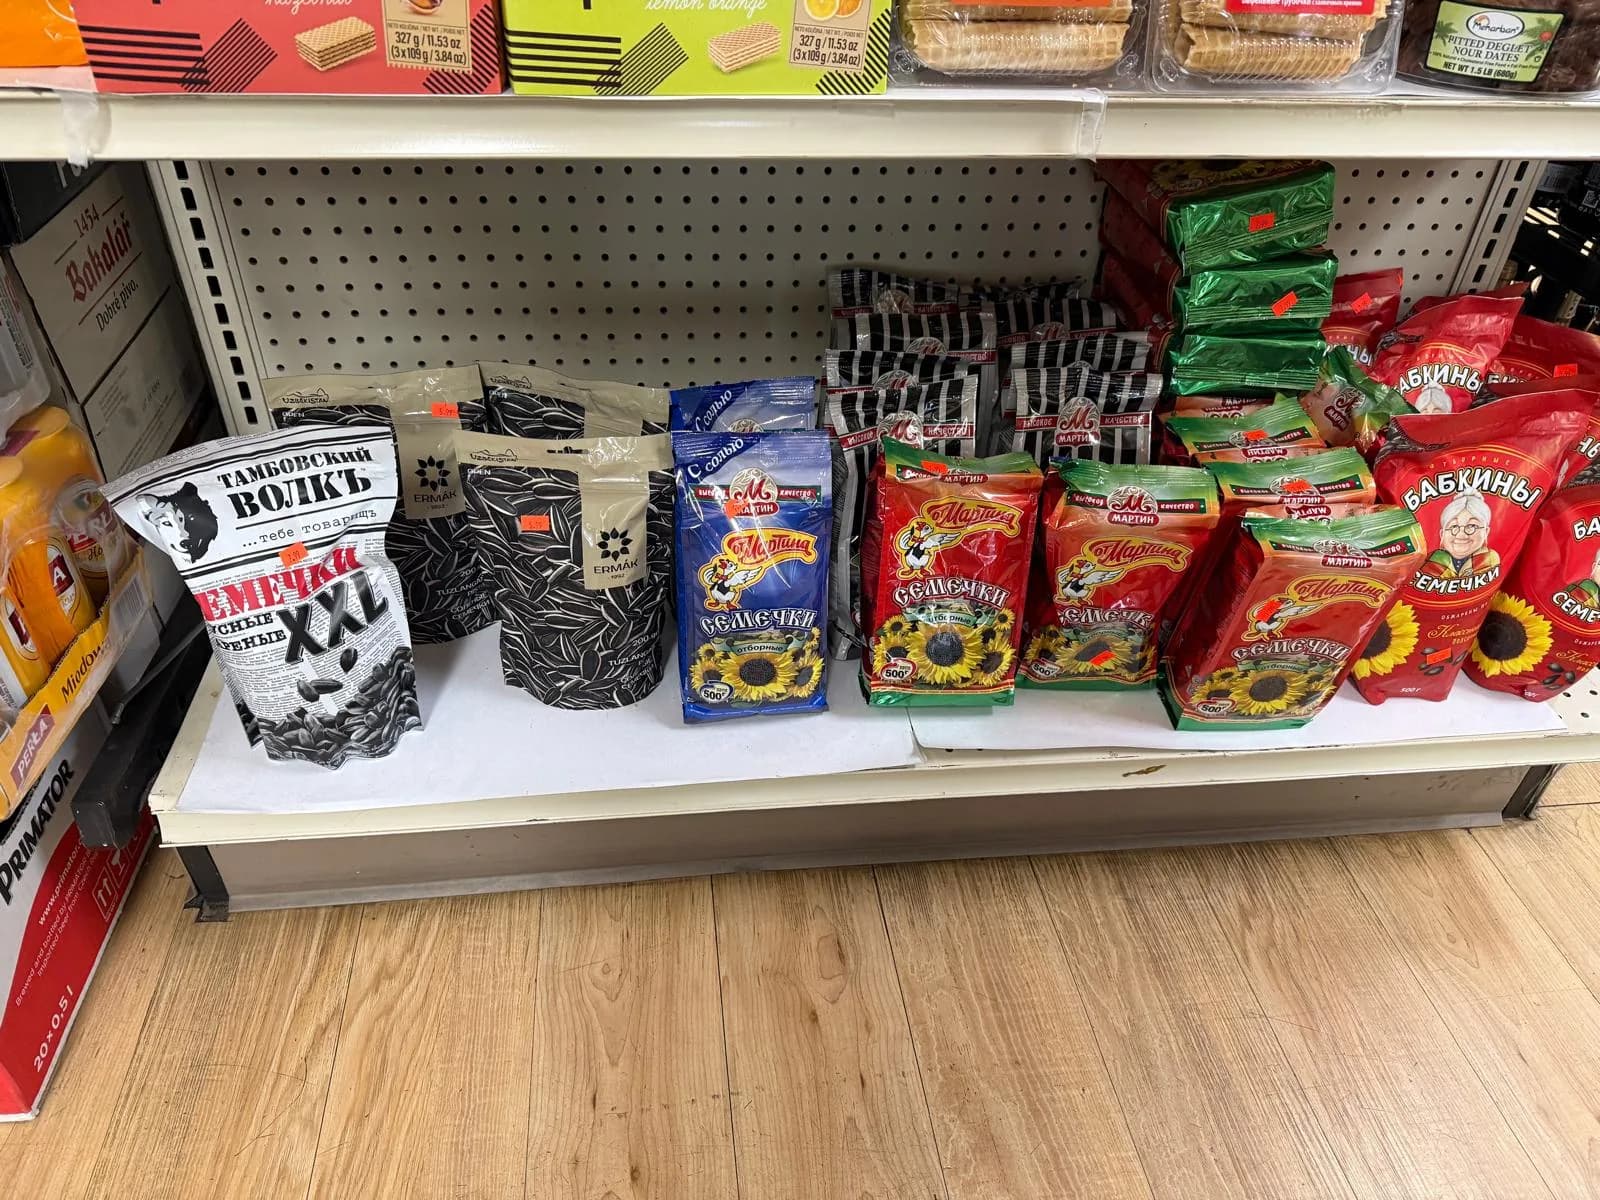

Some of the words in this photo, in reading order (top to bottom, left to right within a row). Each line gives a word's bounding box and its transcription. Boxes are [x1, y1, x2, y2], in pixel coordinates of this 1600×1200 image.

[395, 31, 411, 44] 327
[413, 35, 420, 48] g
[421, 33, 426, 46] /
[427, 34, 449, 49] 11.53
[450, 39, 461, 49] oz
[799, 34, 815, 47] 327
[815, 37, 821, 50] g
[821, 36, 827, 49] /
[828, 37, 848, 51] 11.53
[848, 41, 859, 52] oz
[1448, 34, 1485, 50] PITTED
[1486, 40, 1533, 54] DEGLET
[434, 49, 453, 63] 3.84
[453, 51, 467, 66] oz)
[831, 52, 848, 65] 3.84
[848, 53, 861, 67] oz)
[1452, 45, 1483, 59] NOUR
[1484, 50, 1520, 63] DATES
[1443, 61, 1456, 71] NET
[1457, 63, 1469, 72] WT
[1470, 65, 1482, 75] 1.5
[1483, 67, 1493, 76] LB
[1493, 68, 1518, 80] (680g)
[96, 290, 121, 332] Dobré
[119, 279, 139, 309] pivo.
[1394, 363, 1484, 396] АБКИНЫ
[702, 389, 733, 427] солью
[1058, 433, 1099, 444] МАРТИ
[216, 446, 374, 489] ТАМБОВСКИЙ
[687, 463, 702, 479] С
[704, 438, 745, 472] солью
[226, 468, 372, 520] ВОЛКЪ
[413, 490, 457, 504] ERMÁK
[1403, 467, 1541, 512] БАБКИНЫ
[300, 509, 378, 535] товарищъ
[1111, 514, 1155, 524] МАРТИН
[1105, 540, 1184, 563] Мартина
[1326, 556, 1368, 568] МАРТИН
[460, 566, 477, 578] 200
[593, 558, 639, 575] ERMÁK
[893, 577, 1010, 608] СЕМЕЧКИ
[1307, 578, 1385, 602] Мартина
[1410, 566, 1500, 595] ЕМЕЧКИ
[276, 570, 389, 664] XXL
[701, 607, 818, 636] СЕМЕЧКИ
[632, 635, 649, 647] 200
[737, 643, 784, 653] отборные
[1233, 638, 1351, 661] СЕМЕЧКИ
[17, 718, 49, 779] PERŁA
[0, 759, 75, 906] PRIMATOR
[37, 933, 60, 977] Imported
[57, 913, 71, 936] beer
[68, 895, 81, 917] from
[15, 969, 36, 1007] Brewed
[34, 948, 46, 968] and
[43, 913, 61, 949] bottled
[59, 901, 69, 916] by
[34, 1042, 49, 1073] 20
[46, 1029, 54, 1044] x
